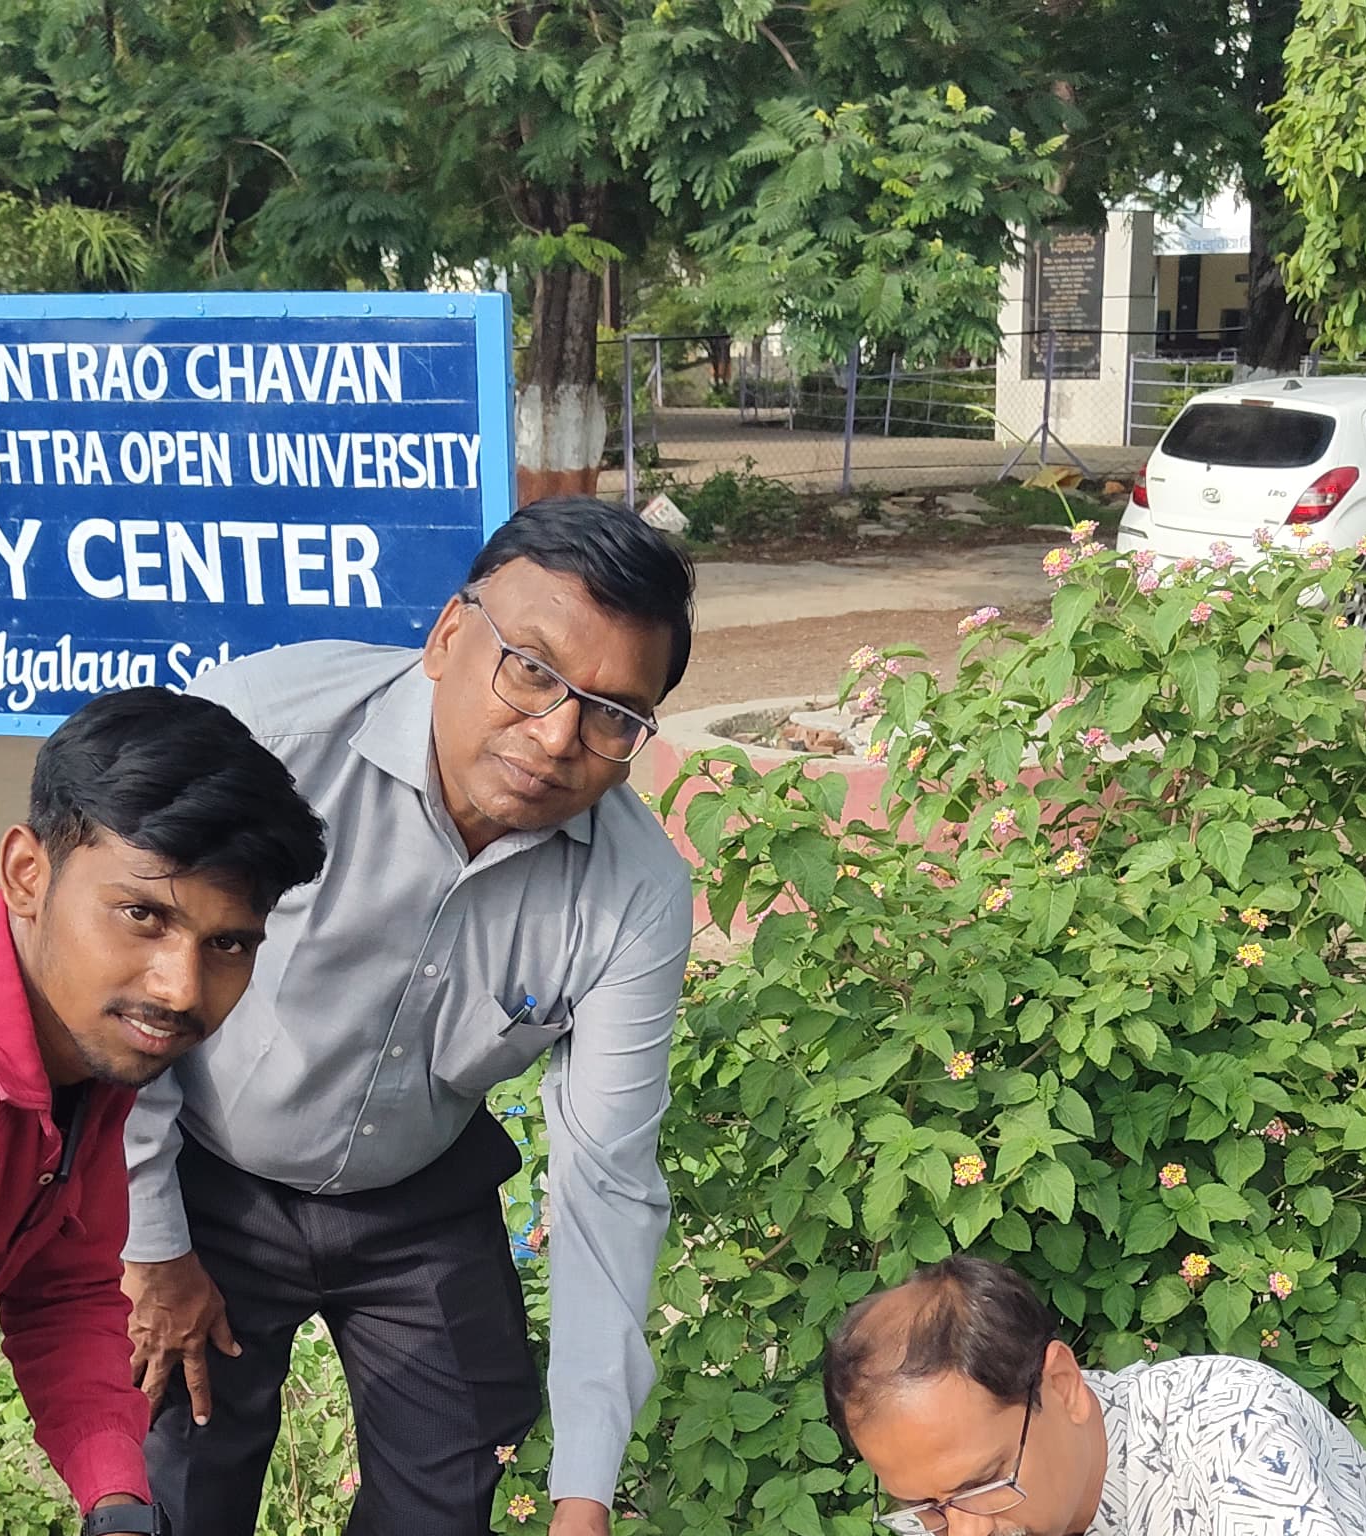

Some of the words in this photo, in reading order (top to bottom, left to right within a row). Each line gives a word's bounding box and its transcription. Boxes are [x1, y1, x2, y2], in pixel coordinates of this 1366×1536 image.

[185, 343, 402, 404] CHAVAN
[120, 432, 232, 487] OPEN
[249, 433, 481, 489] UNIVERSITY
[68, 518, 382, 608] CENTER
